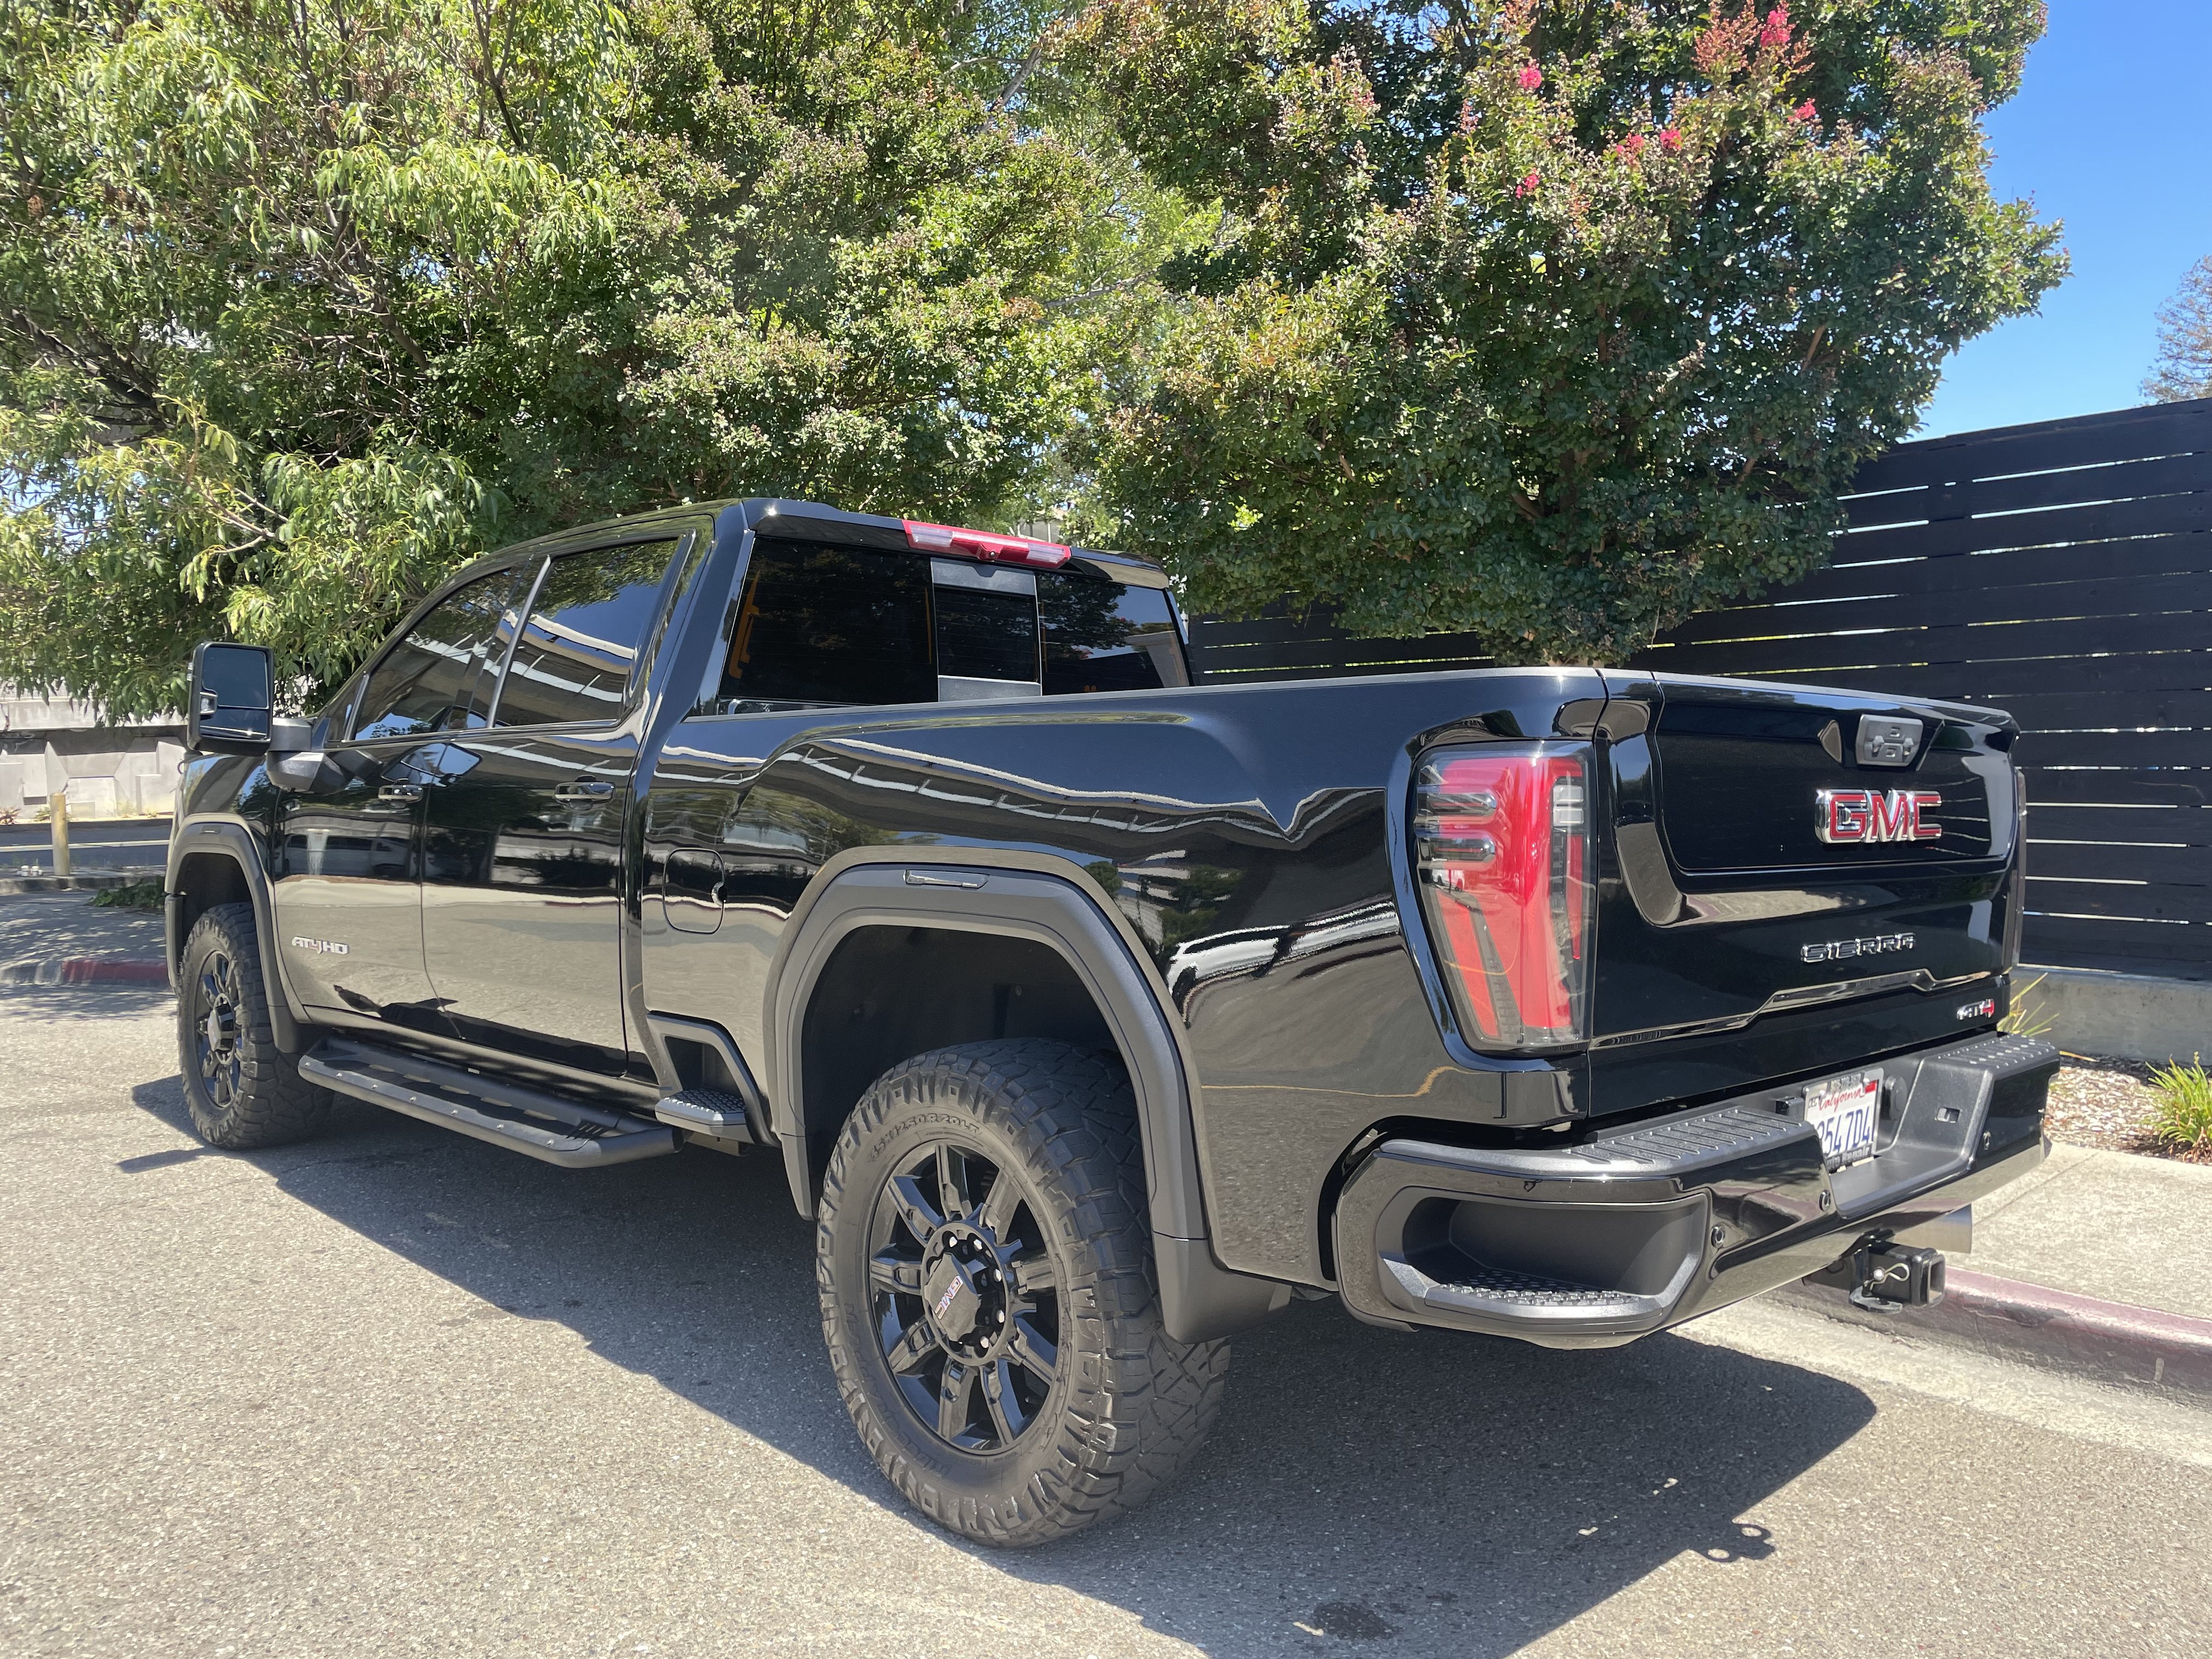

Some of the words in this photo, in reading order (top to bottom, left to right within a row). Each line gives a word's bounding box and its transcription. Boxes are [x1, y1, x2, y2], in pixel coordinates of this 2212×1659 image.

[1815, 789, 1942, 843] GMC
[1801, 933, 1916, 962] SIERRA
[1819, 1088, 1865, 1112] California
[935, 1275, 963, 1319] GMC
